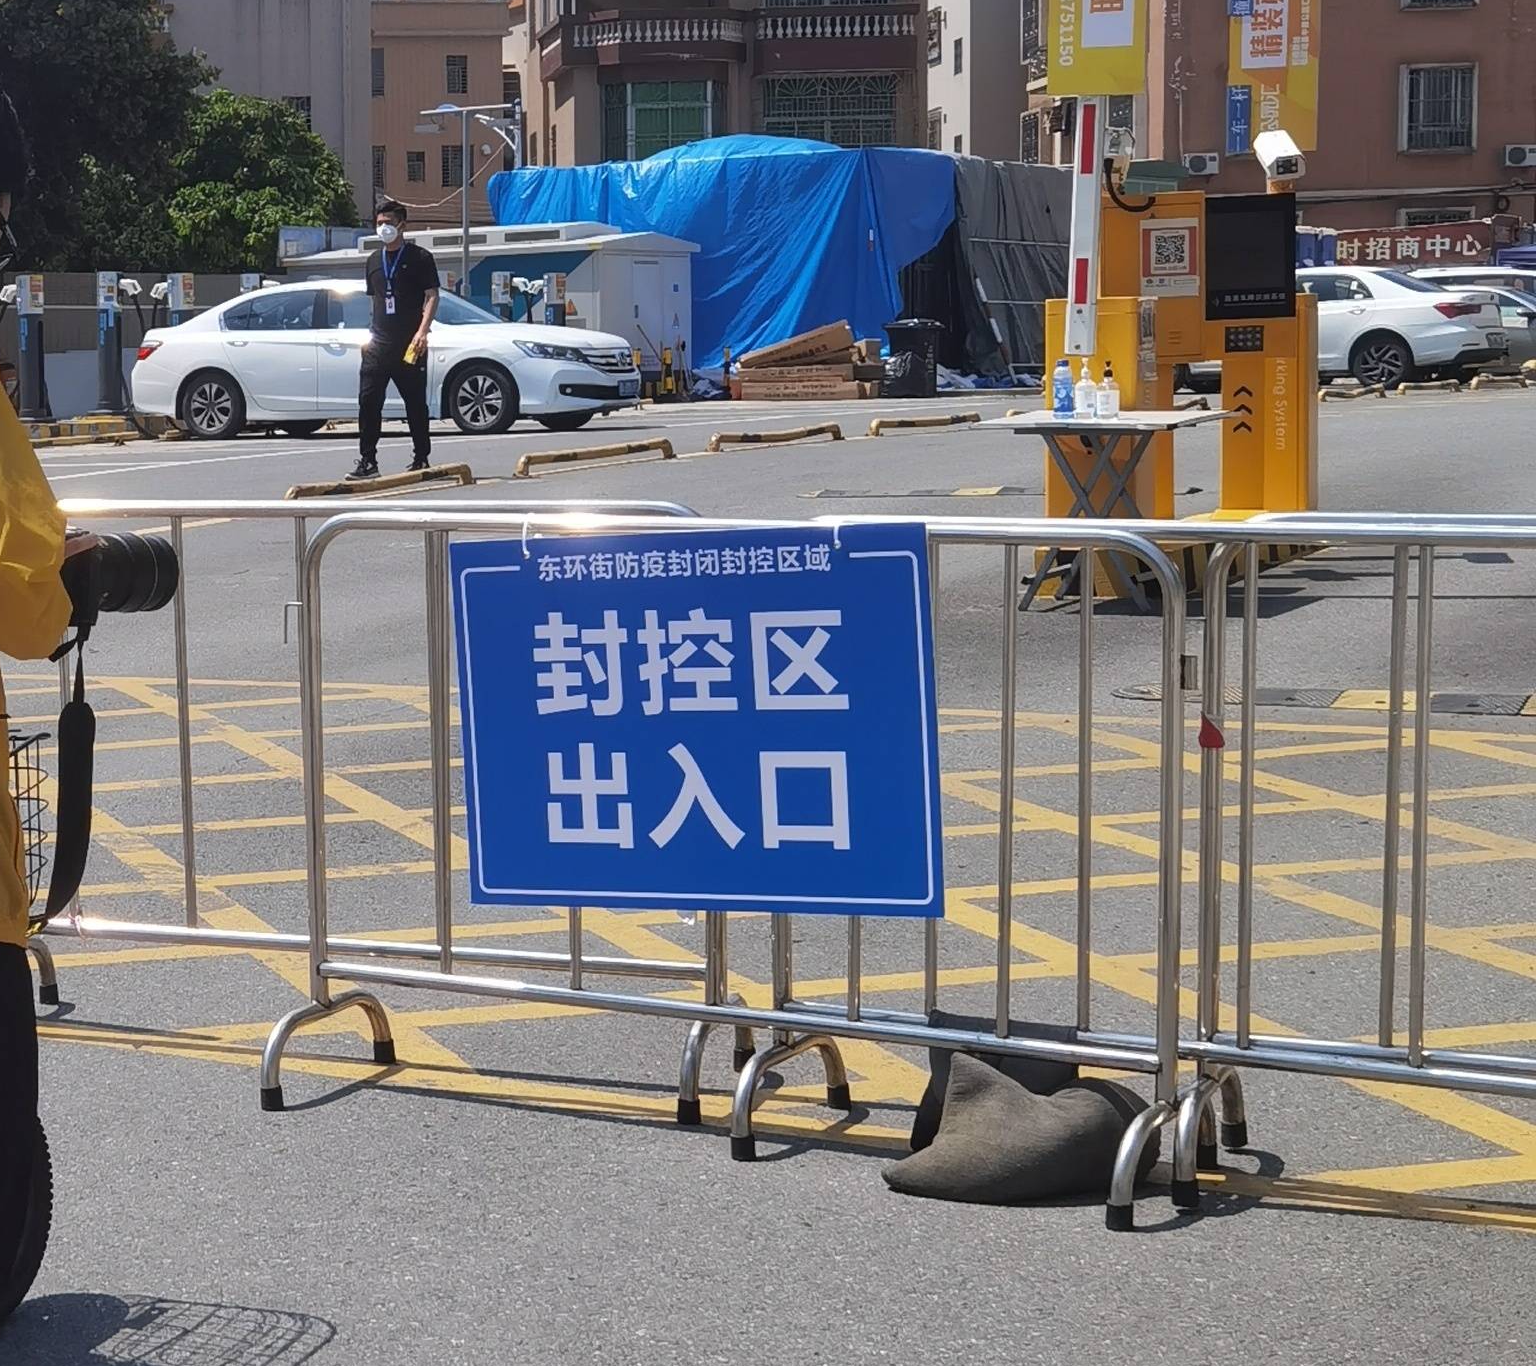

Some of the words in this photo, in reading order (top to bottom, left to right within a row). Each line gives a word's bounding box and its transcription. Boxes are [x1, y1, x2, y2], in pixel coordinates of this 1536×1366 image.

[537, 543, 832, 583] 东环街防疫封闭封控区域
[533, 607, 851, 717] 封控区
[546, 742, 852, 851] 出入口
